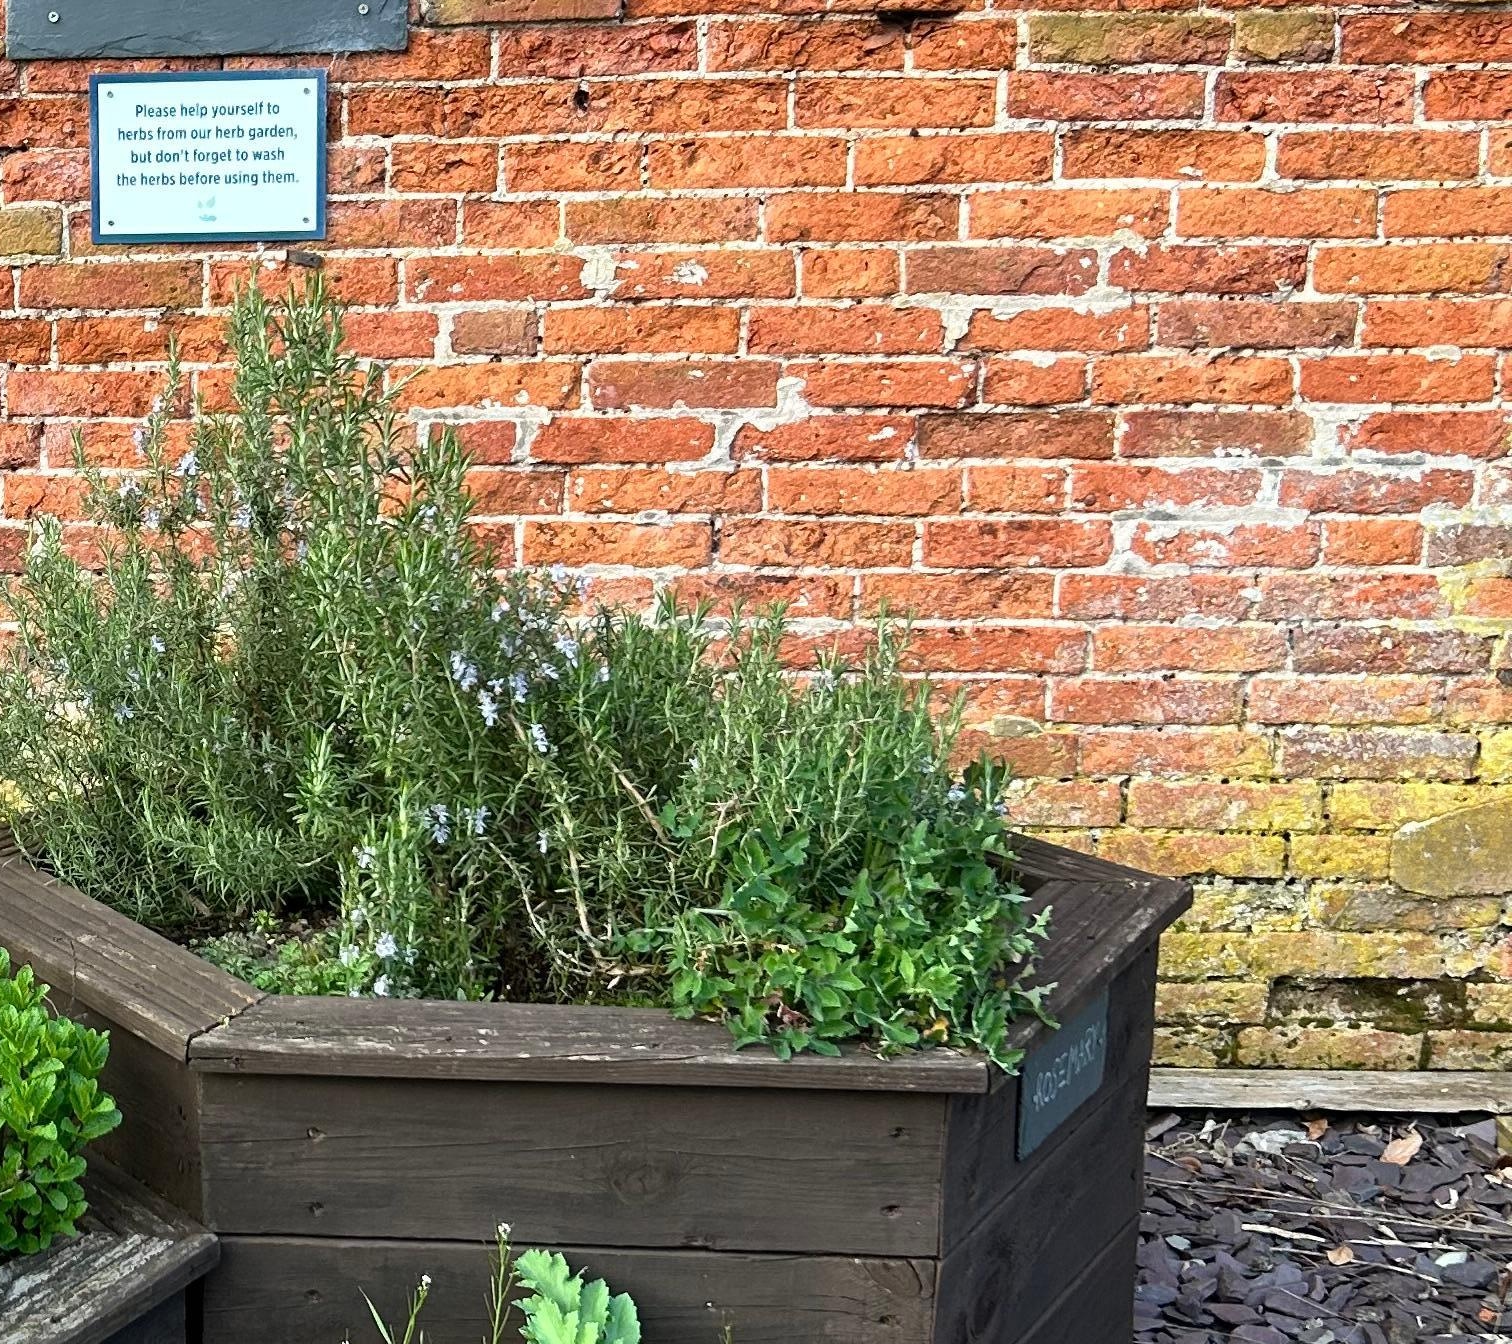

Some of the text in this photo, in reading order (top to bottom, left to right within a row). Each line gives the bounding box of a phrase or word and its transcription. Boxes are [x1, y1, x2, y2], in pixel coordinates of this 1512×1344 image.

[134, 101, 280, 118] Please help yourself to
[117, 124, 297, 141] herbs from our herb garden,
[130, 146, 284, 163] but don't forget to wash
[116, 170, 299, 186] the herbs before using them.
